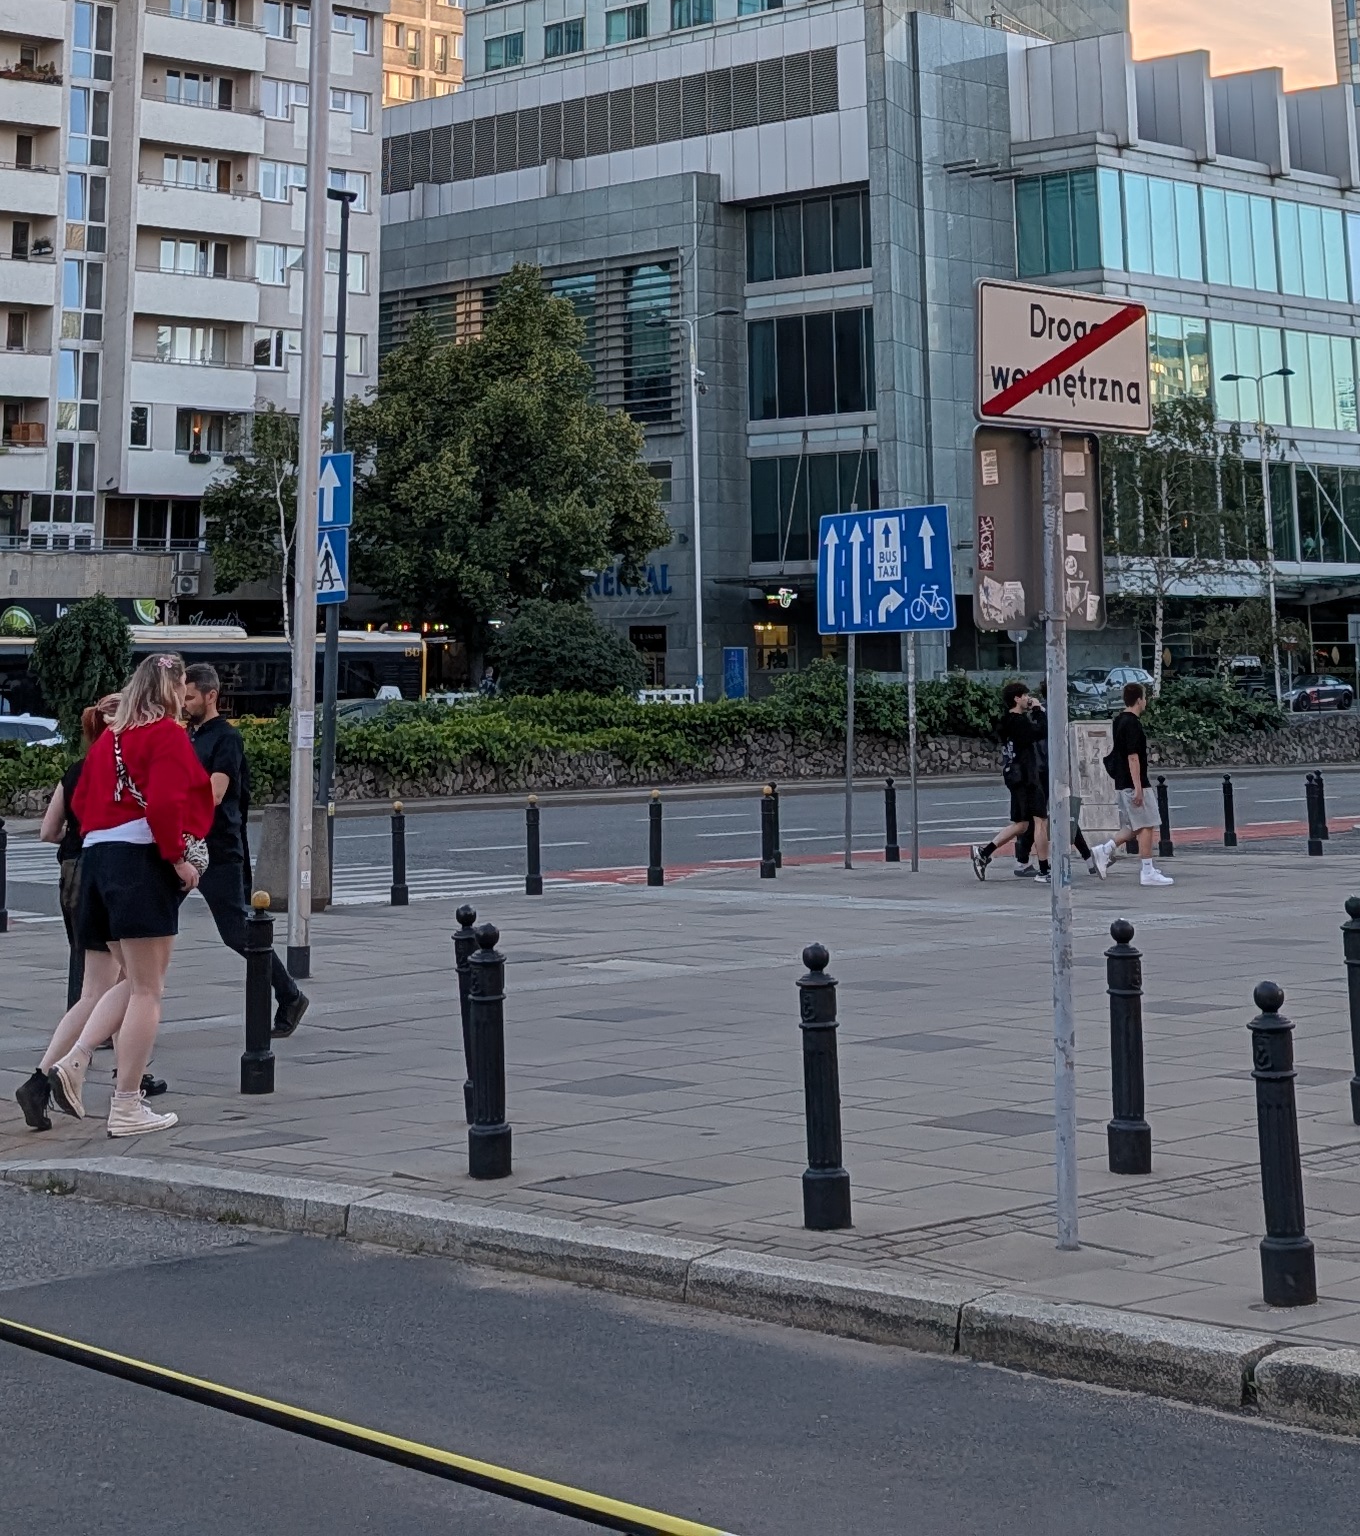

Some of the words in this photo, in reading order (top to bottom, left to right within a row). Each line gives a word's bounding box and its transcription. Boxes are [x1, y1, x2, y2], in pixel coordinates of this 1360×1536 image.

[1030, 303, 1103, 343] Drog
[990, 365, 1141, 407] wenętrzna
[879, 550, 897, 563] BUS
[877, 565, 899, 578] TAXI
